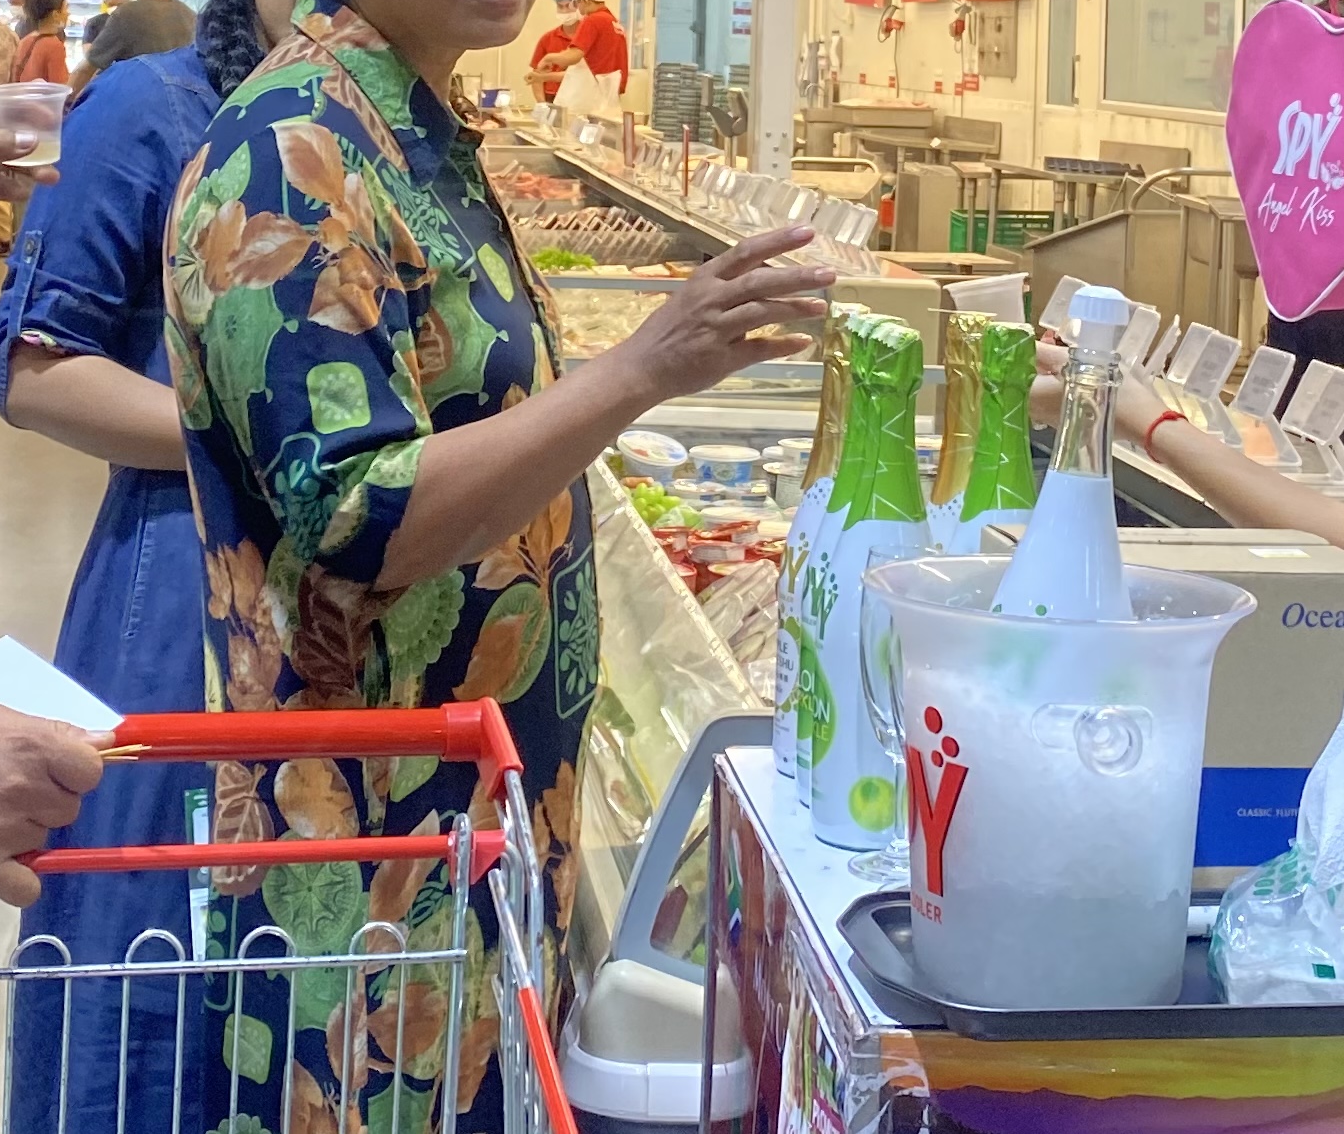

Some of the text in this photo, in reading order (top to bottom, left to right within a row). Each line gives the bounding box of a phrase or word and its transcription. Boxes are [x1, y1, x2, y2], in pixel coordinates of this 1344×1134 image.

[1272, 94, 1343, 180] SPY
[1258, 183, 1335, 235] Angel Kiss
[907, 745, 970, 898] Y
